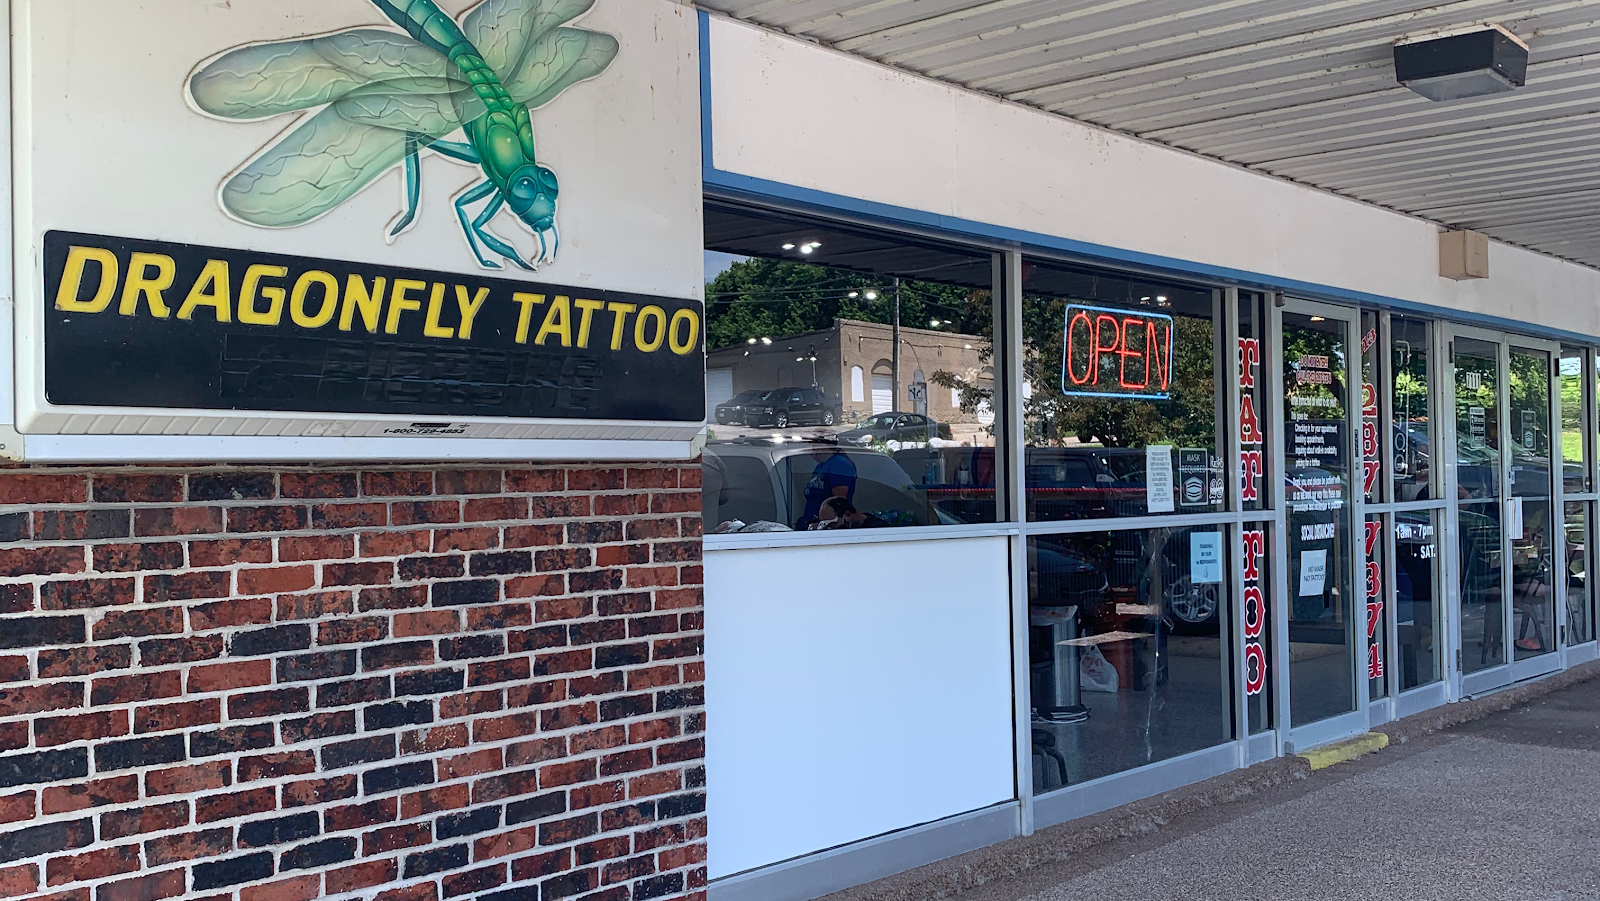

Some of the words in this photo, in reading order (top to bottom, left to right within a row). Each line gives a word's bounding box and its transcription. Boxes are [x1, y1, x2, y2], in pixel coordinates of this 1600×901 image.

[54, 245, 491, 340] DRAGONFLY
[512, 291, 700, 356] TATTOO
[1067, 312, 1170, 390] OPEN
[1181, 465, 1206, 474] REQUIRED
[1417, 523, 1434, 539] 7pm
[1420, 544, 1436, 560] SAT.
